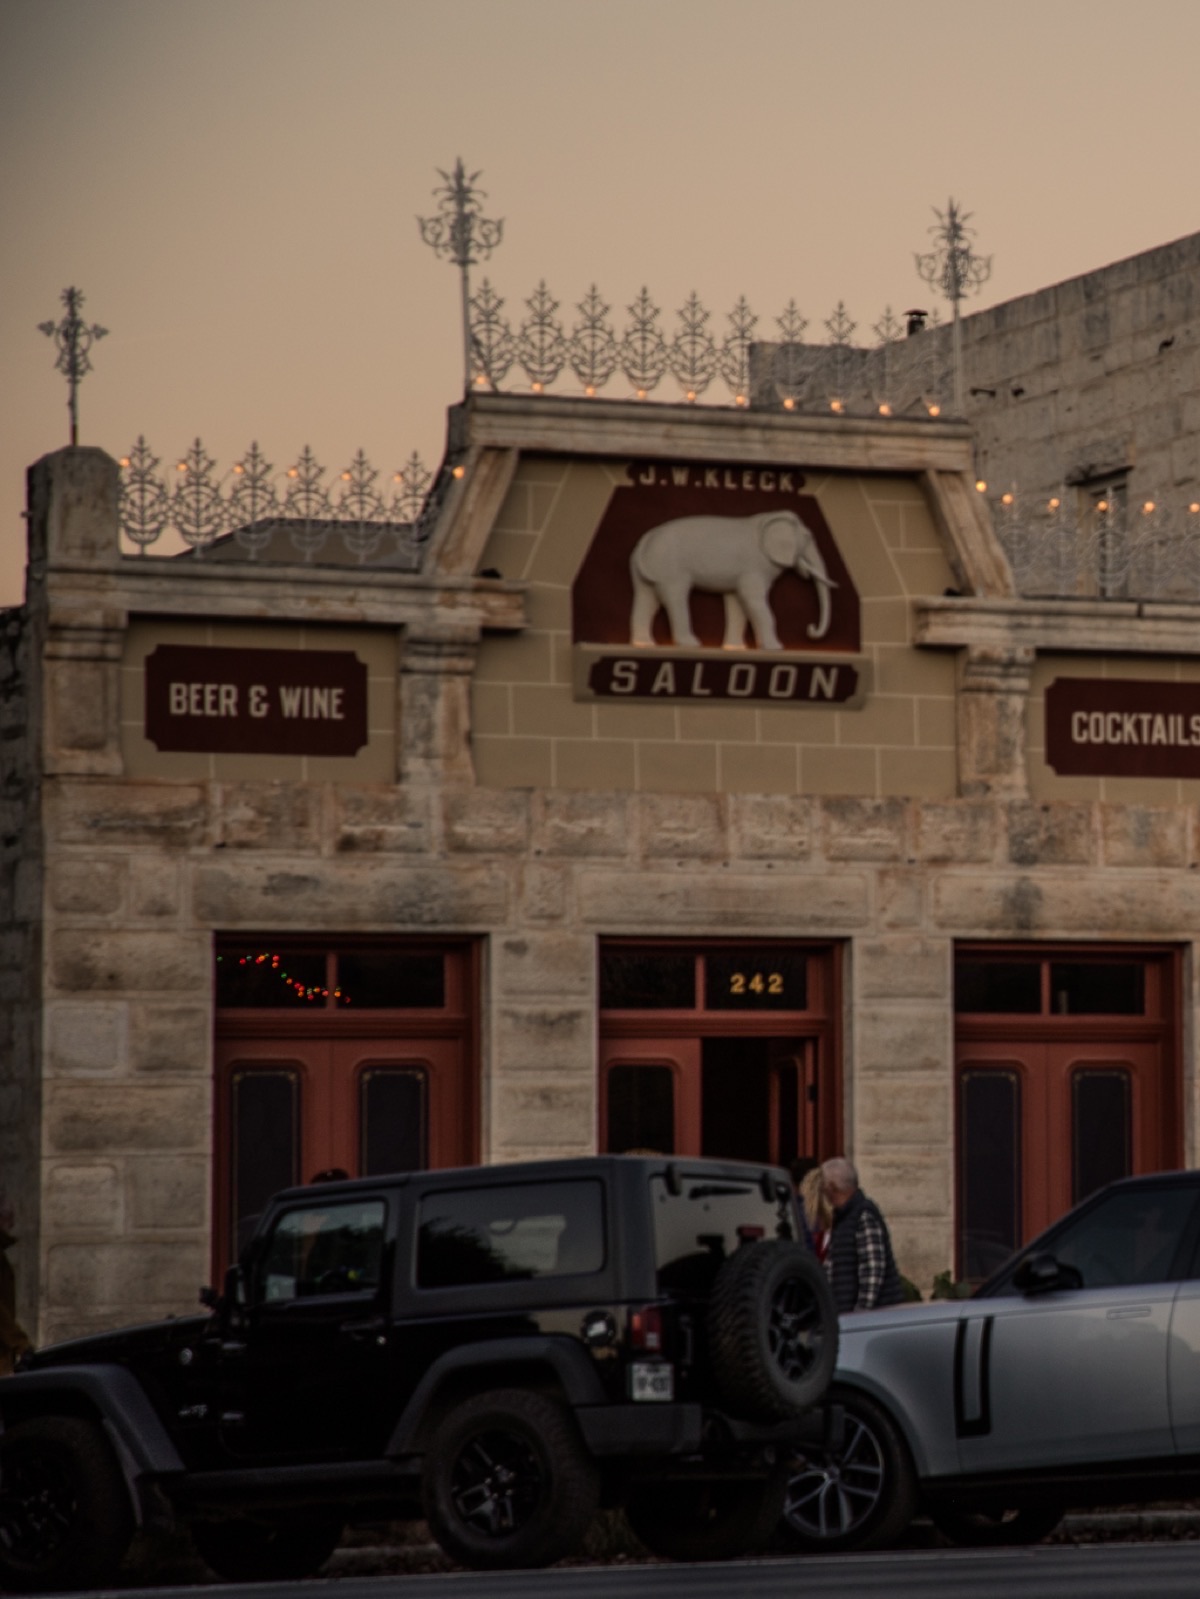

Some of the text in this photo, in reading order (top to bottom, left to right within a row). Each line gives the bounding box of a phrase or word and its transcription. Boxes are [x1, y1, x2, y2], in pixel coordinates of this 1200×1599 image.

[609, 660, 840, 699] SALOON
[169, 682, 345, 720] BEER & WINE
[729, 971, 785, 995] 242
